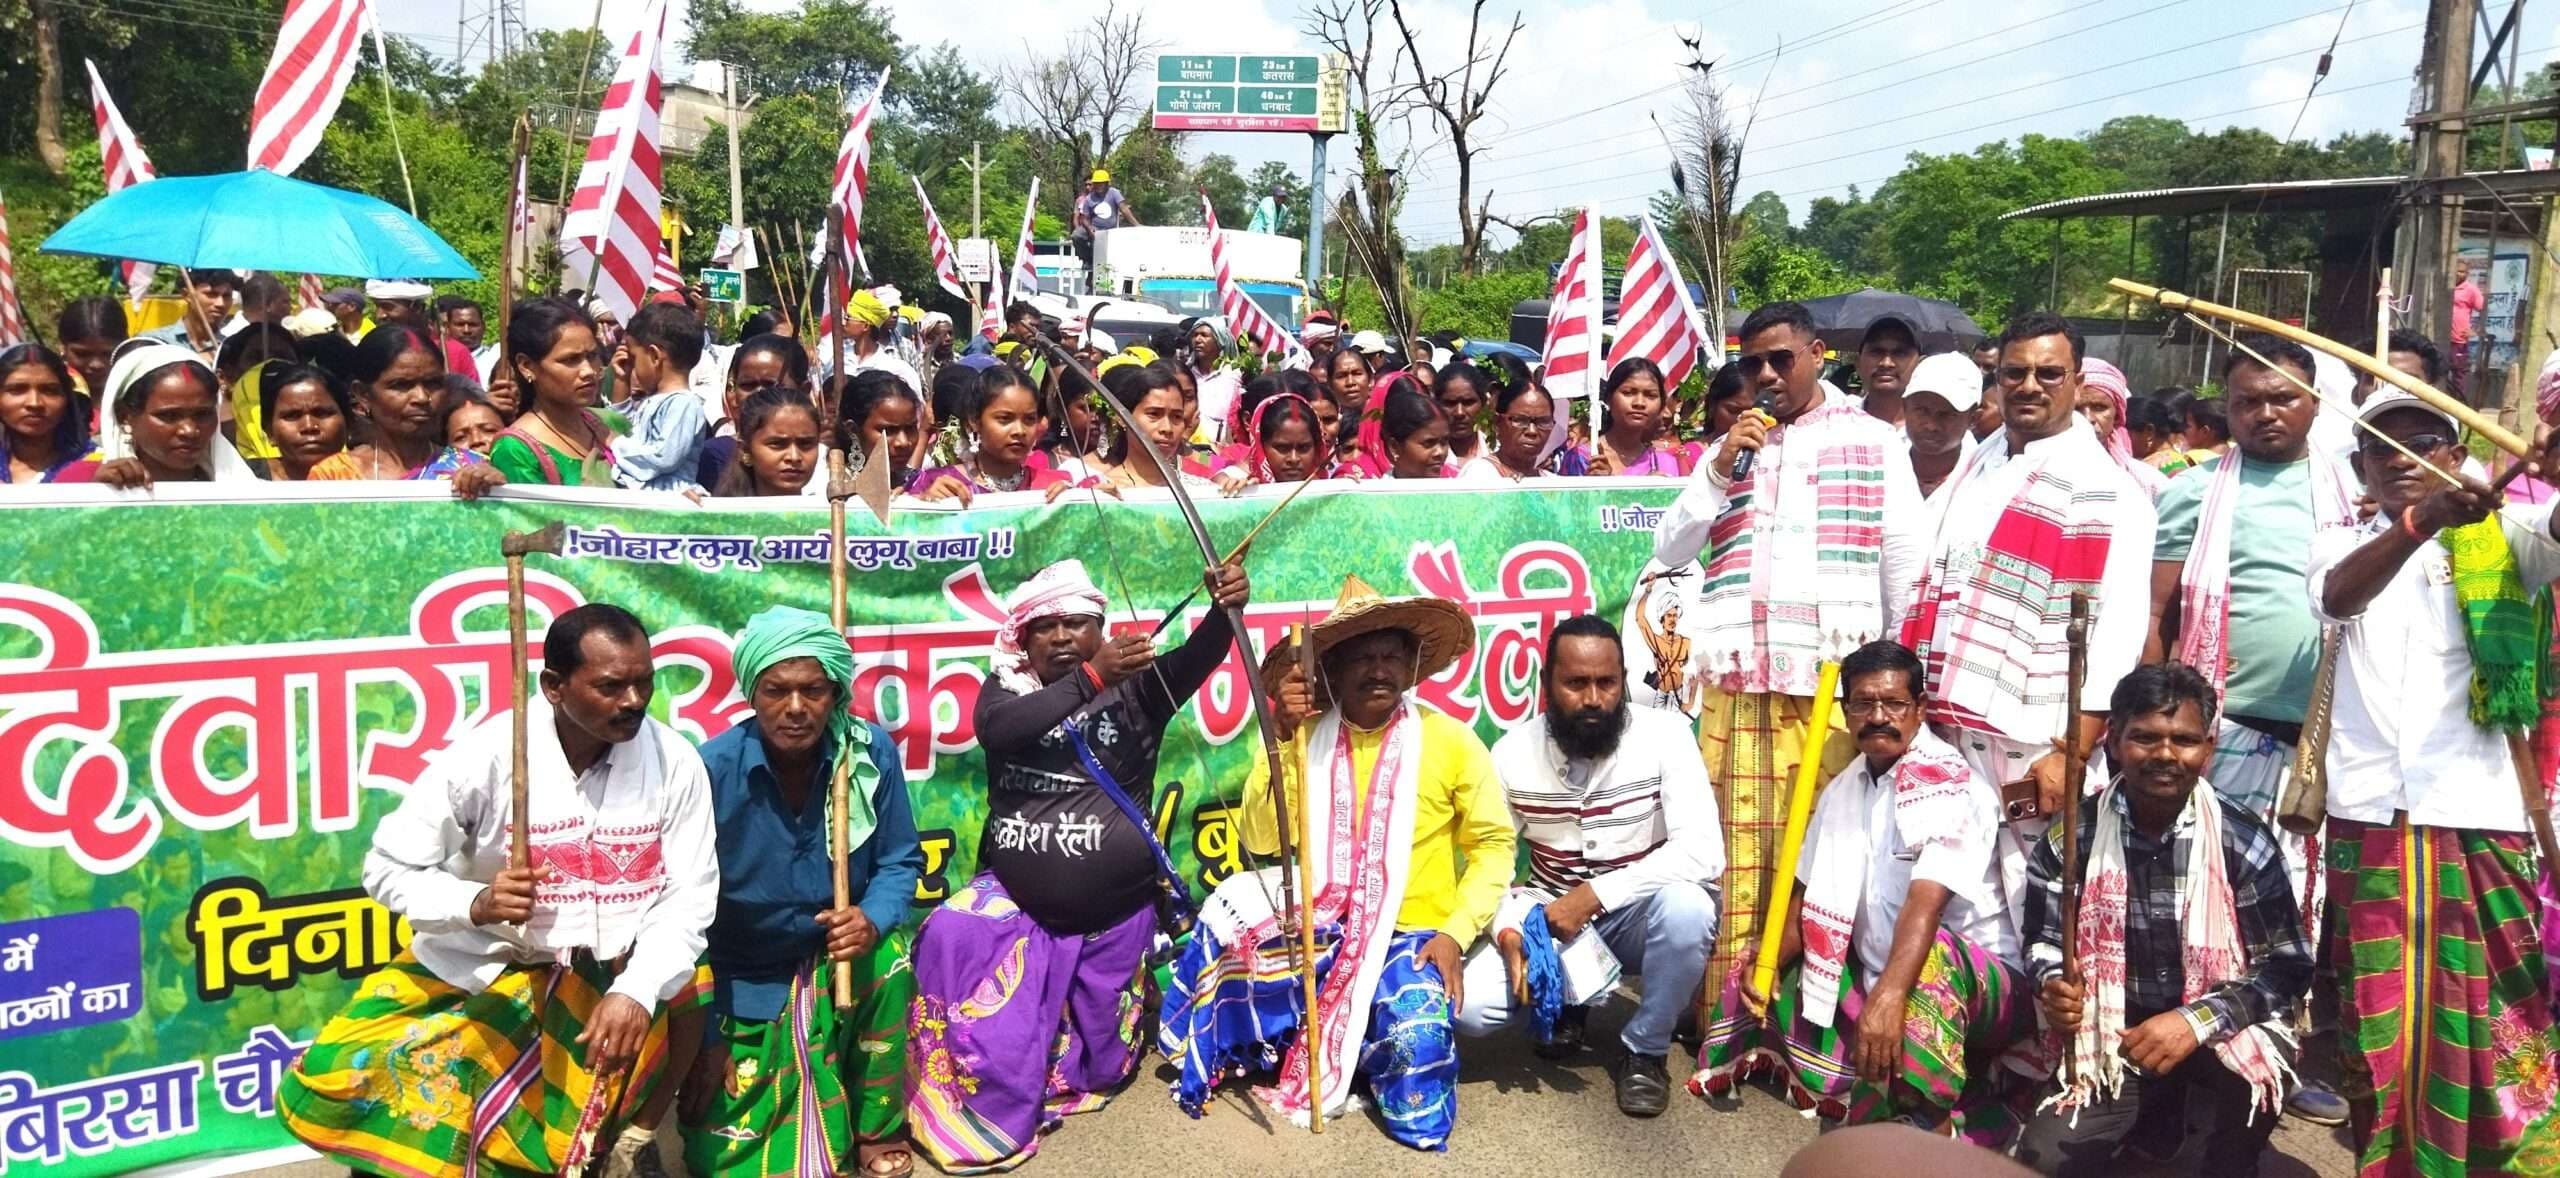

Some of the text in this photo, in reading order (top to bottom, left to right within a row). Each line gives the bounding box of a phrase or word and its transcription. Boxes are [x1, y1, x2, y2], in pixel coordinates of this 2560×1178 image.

[1602, 506, 1666, 529] !! जोहा
[688, 538, 758, 567] लुगू
[848, 539, 912, 567] लुगू
[917, 537, 978, 560] बाबा
[989, 531, 1013, 556] !!
[1055, 811, 1105, 858] रैली
[2, 933, 39, 972] में
[0, 981, 131, 1030] ठनों का
[0, 1031, 318, 1158] बिरसा चौ
